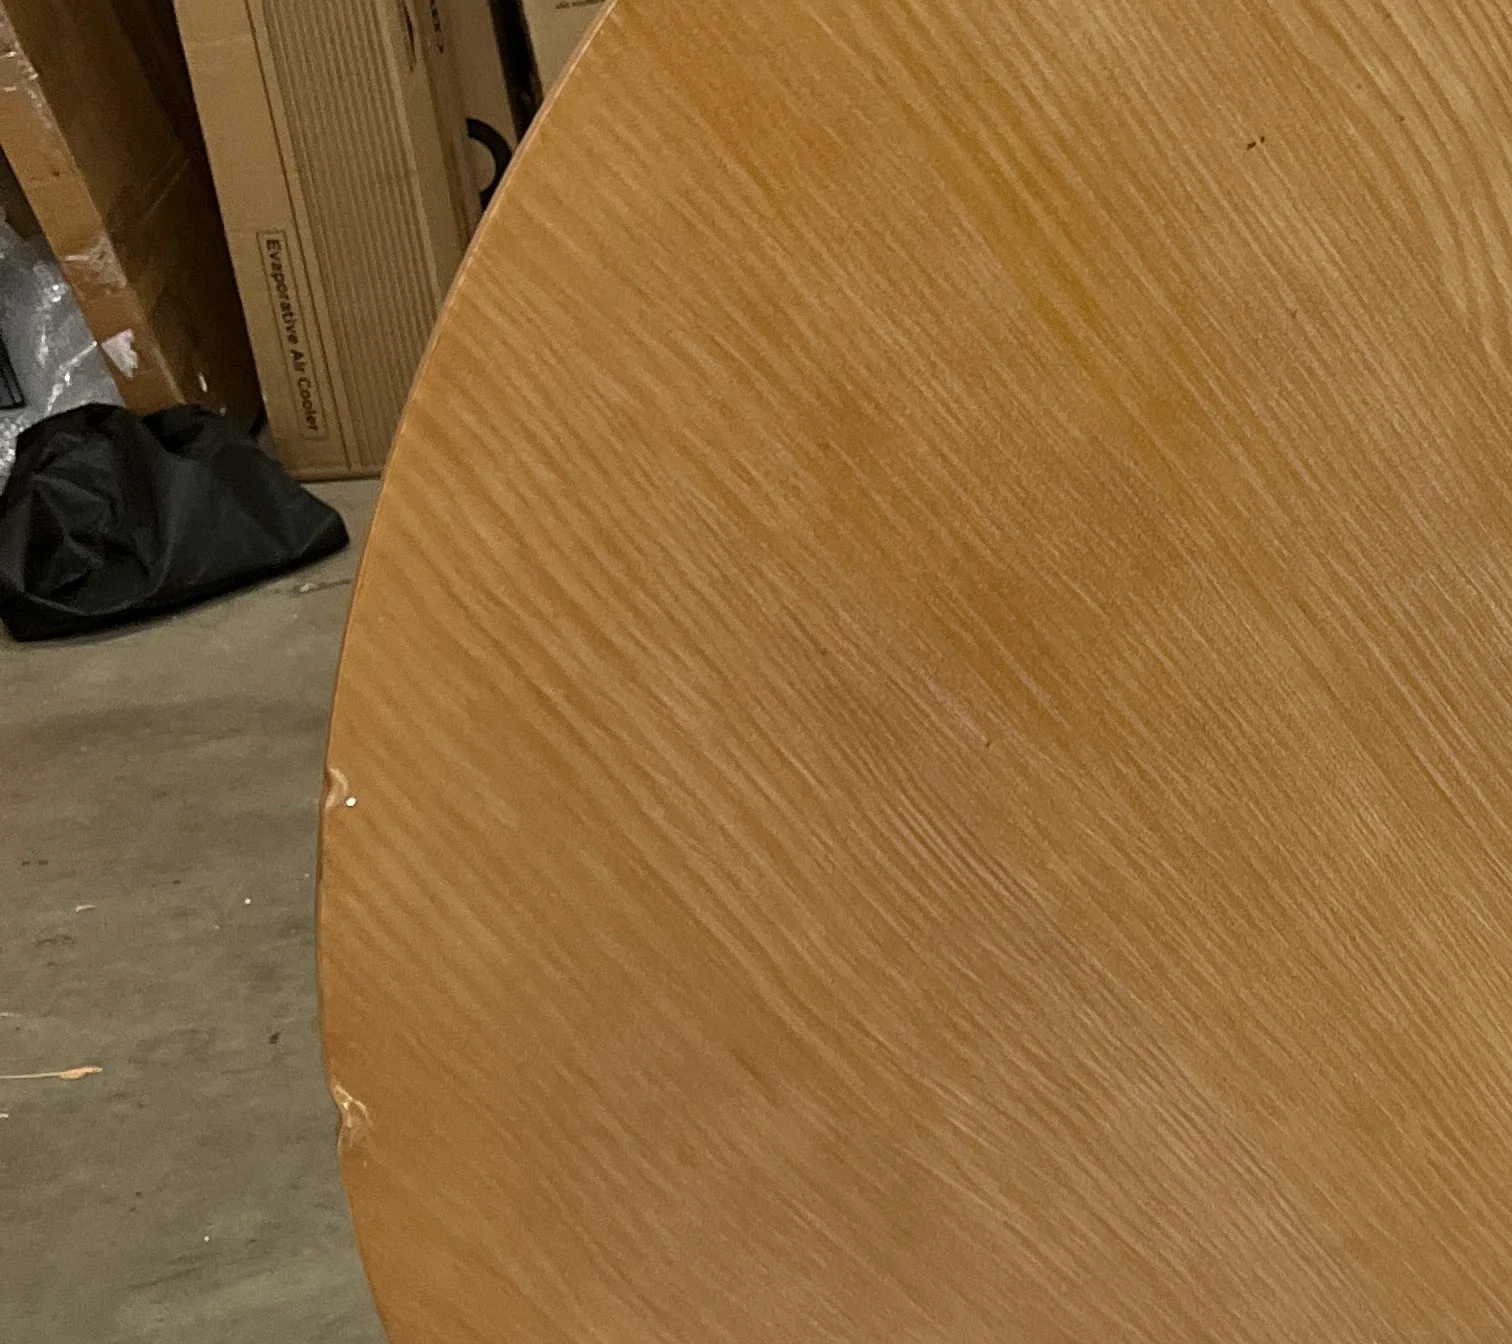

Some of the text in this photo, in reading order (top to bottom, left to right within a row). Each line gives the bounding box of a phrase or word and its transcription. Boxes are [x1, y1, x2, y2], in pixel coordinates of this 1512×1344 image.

[265, 238, 319, 433] Evaporative Air Cooler
